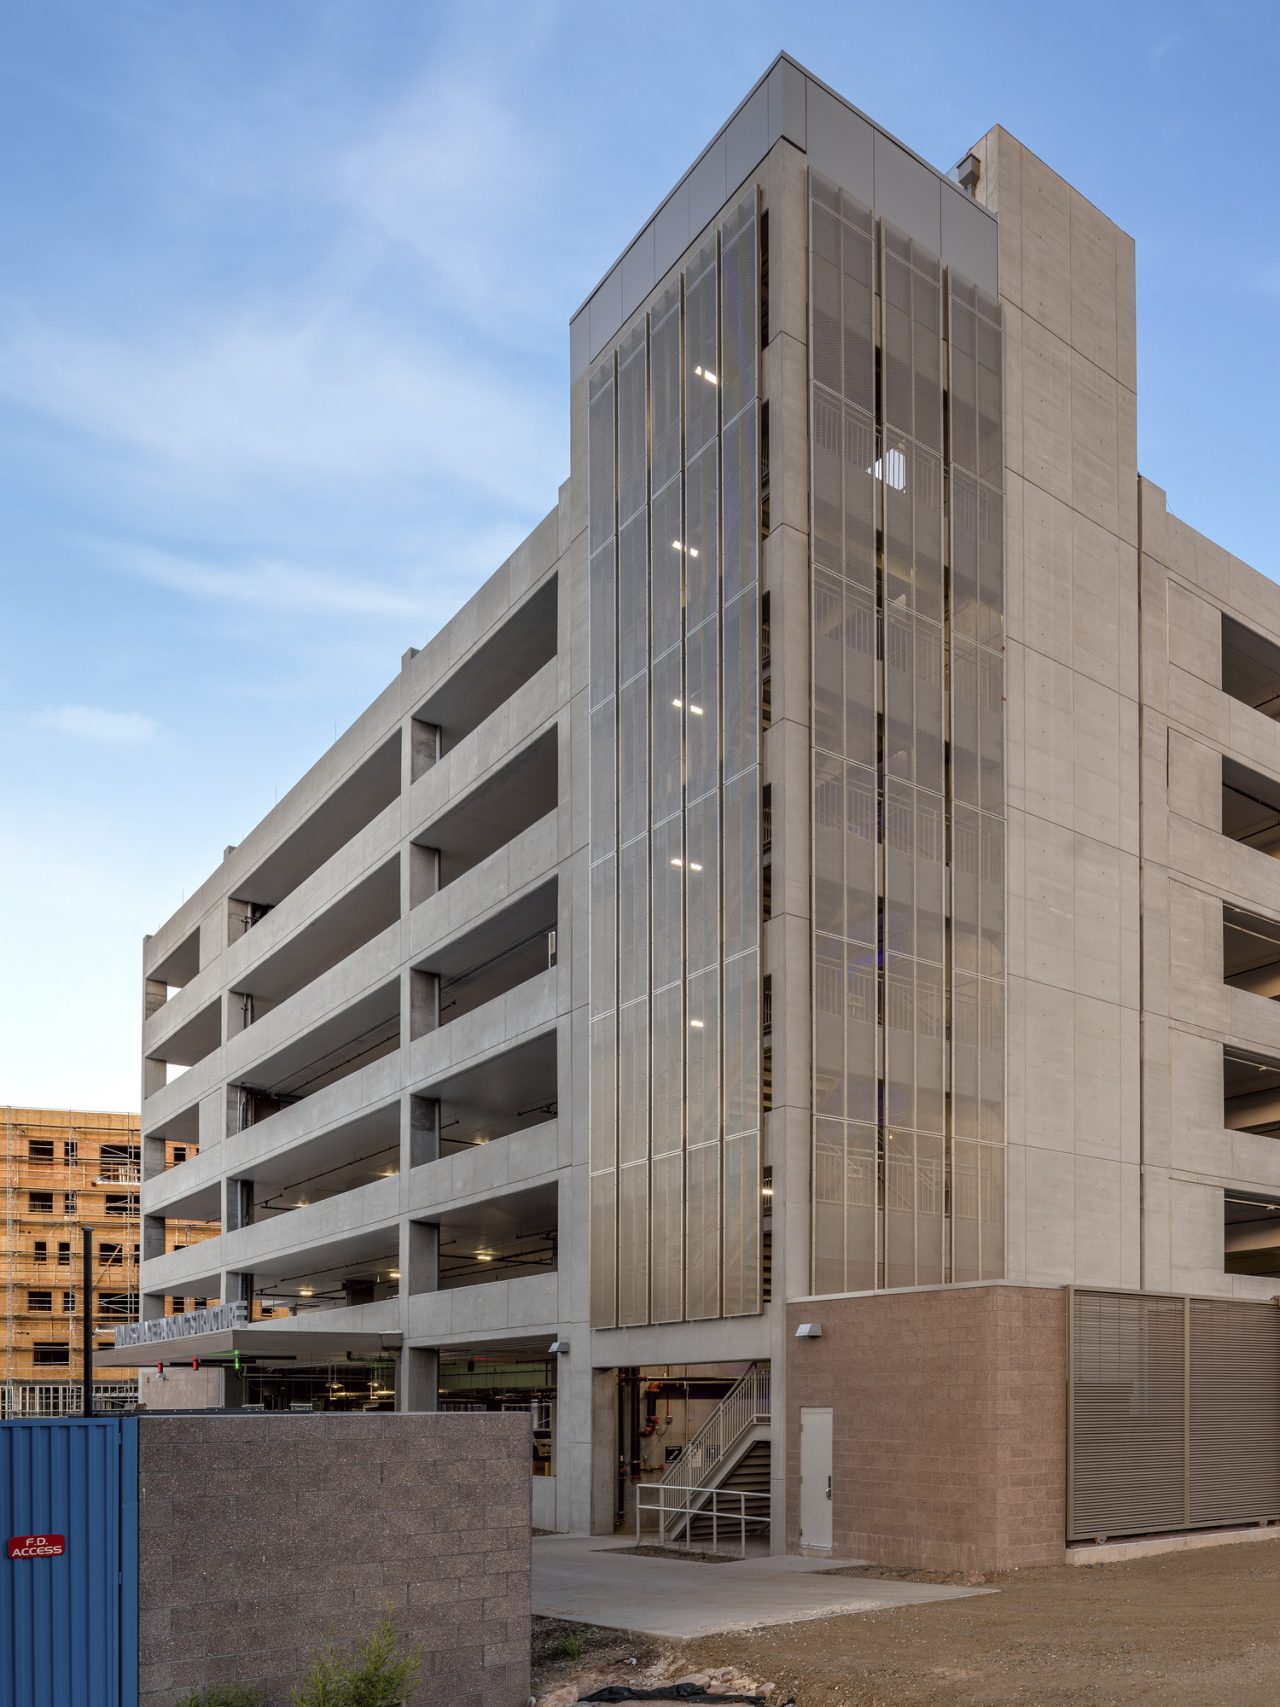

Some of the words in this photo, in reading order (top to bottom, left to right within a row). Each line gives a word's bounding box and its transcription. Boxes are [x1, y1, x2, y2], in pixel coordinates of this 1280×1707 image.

[190, 1300, 247, 1335] STRUCTURE
[26, 1537, 49, 1546] F.D.
[12, 1545, 62, 1557] ACCESS
